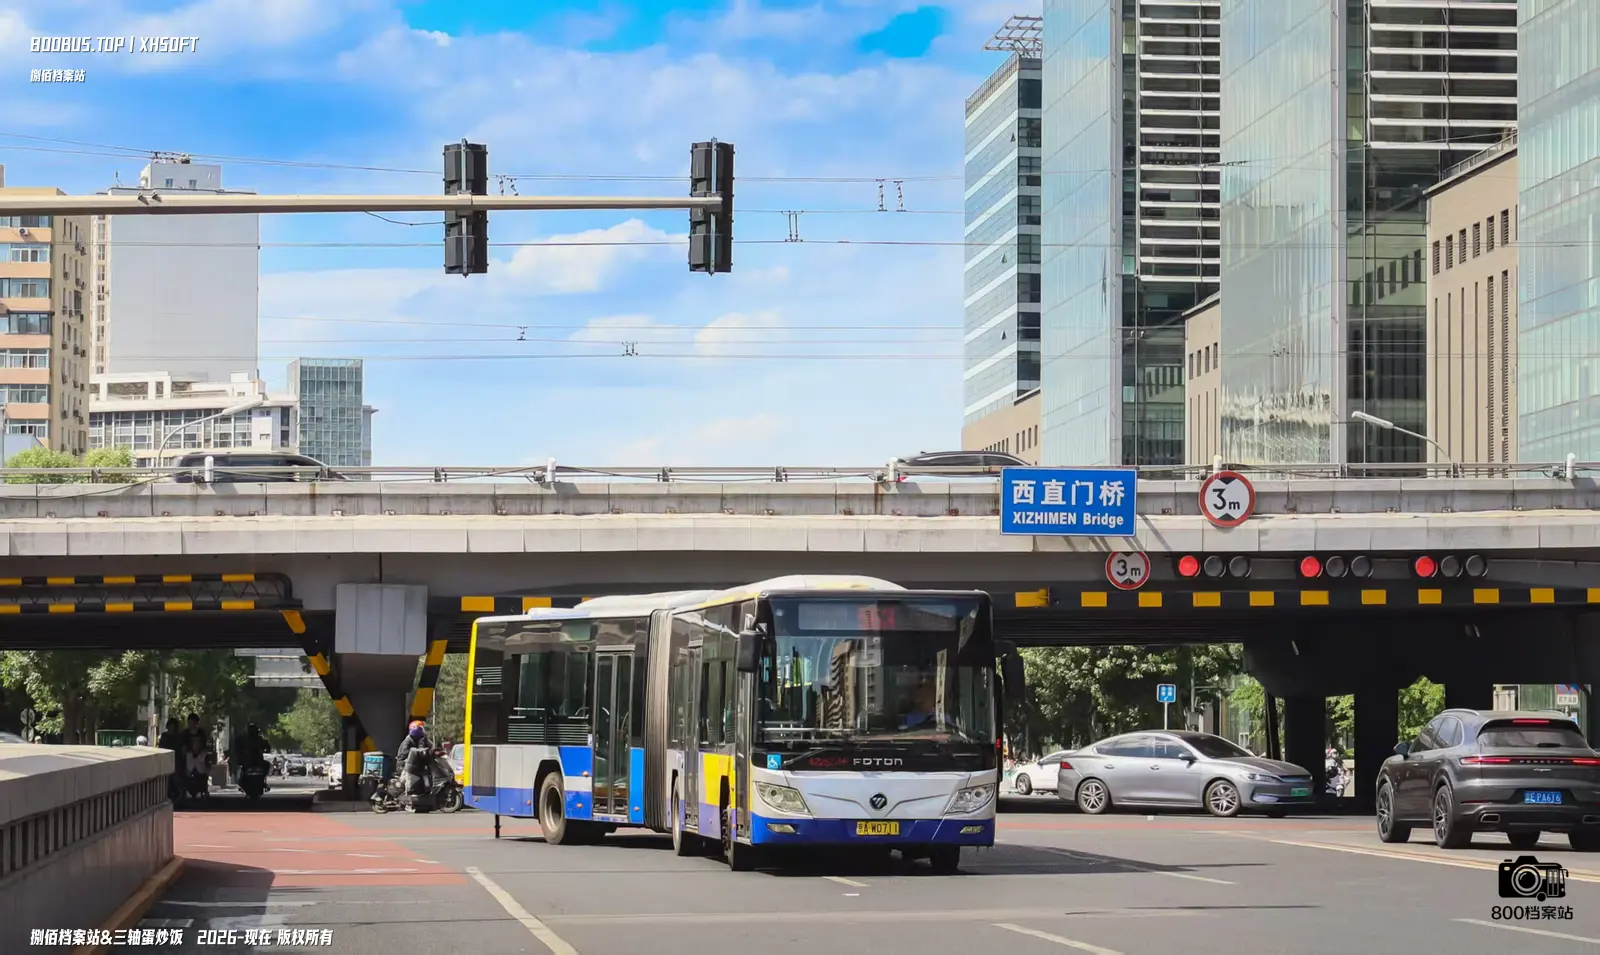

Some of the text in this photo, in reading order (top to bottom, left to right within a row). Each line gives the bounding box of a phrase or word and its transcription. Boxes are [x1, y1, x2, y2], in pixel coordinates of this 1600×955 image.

[1011, 478, 1125, 507] 西直门桥
[1012, 511, 1124, 529] XIZHIMEN Bridge
